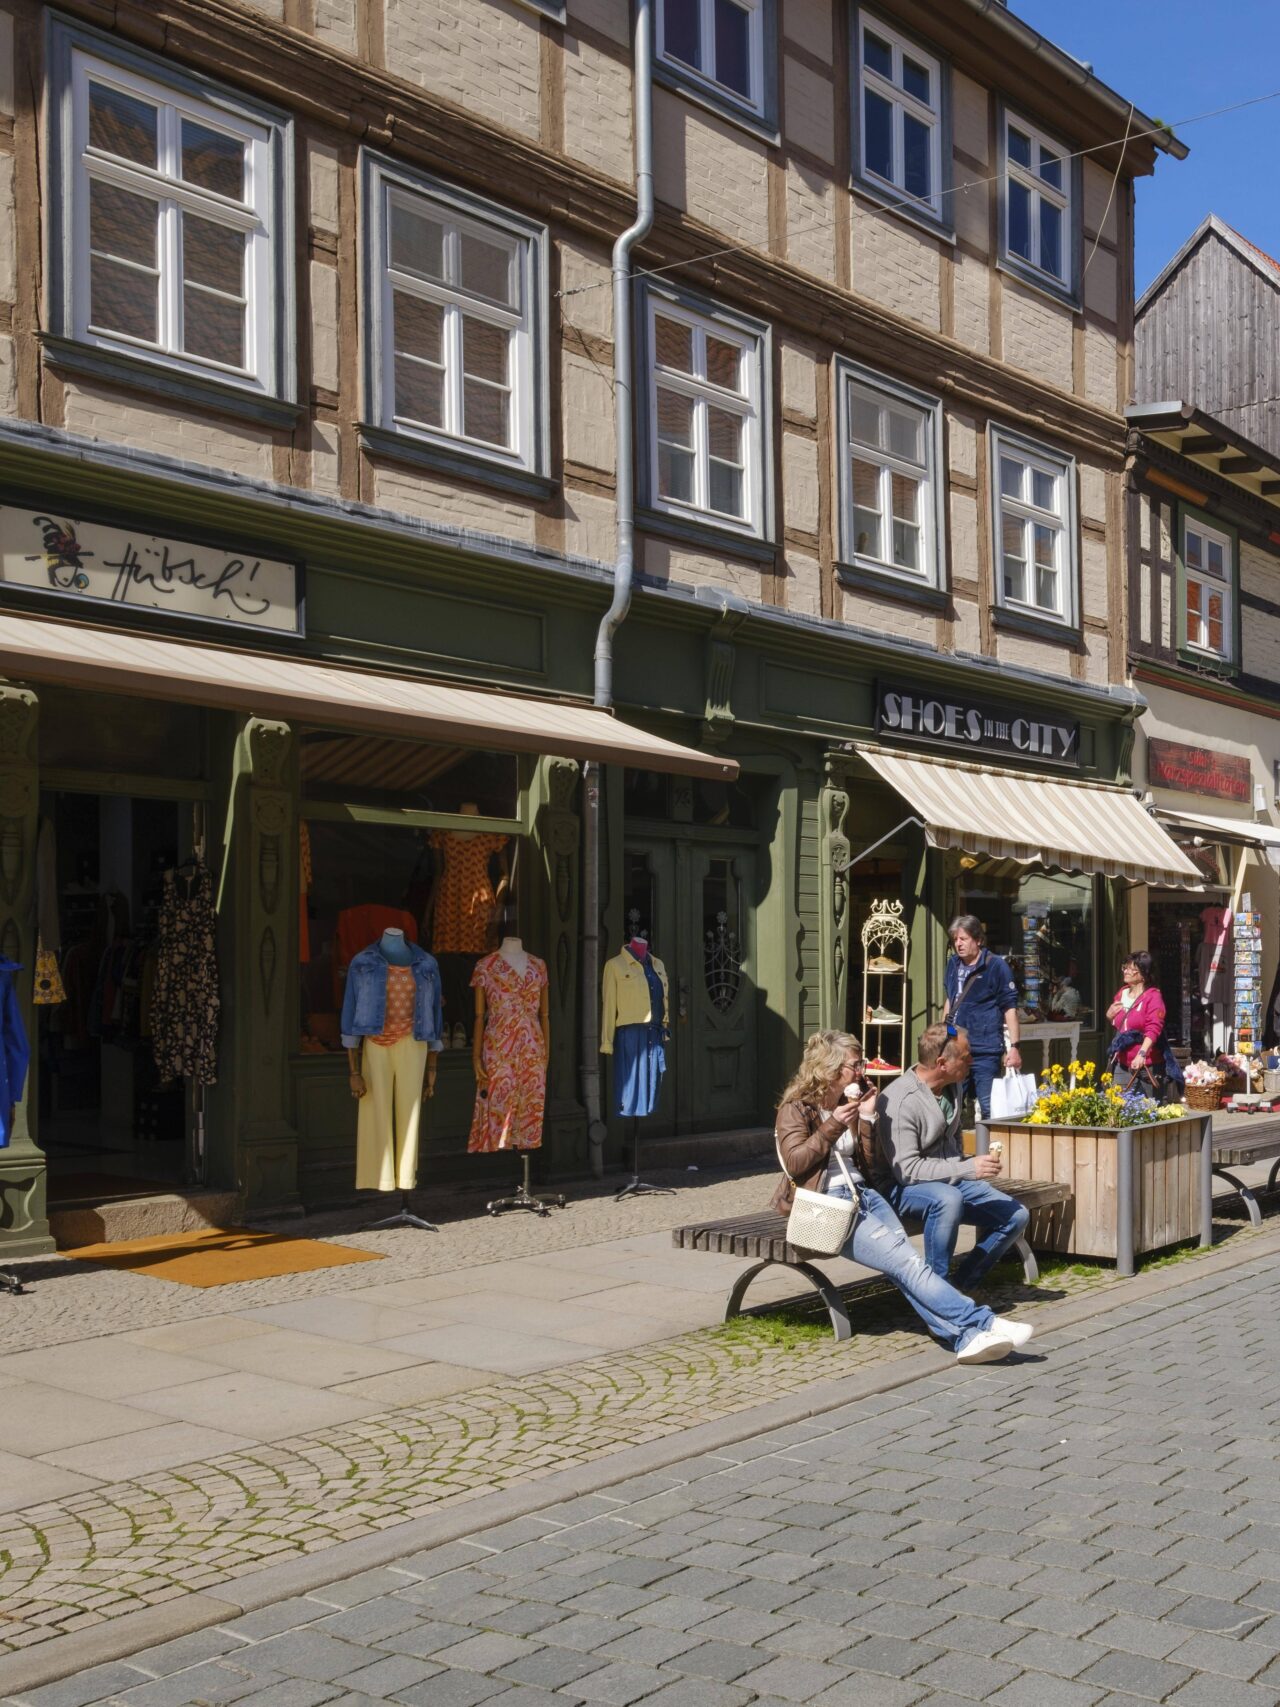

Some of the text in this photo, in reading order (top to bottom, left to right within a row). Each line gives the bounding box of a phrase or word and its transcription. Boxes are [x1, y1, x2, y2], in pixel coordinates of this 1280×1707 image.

[104, 543, 270, 615] Hübsch!
[881, 692, 1076, 757] SHOES IN THE CITY
